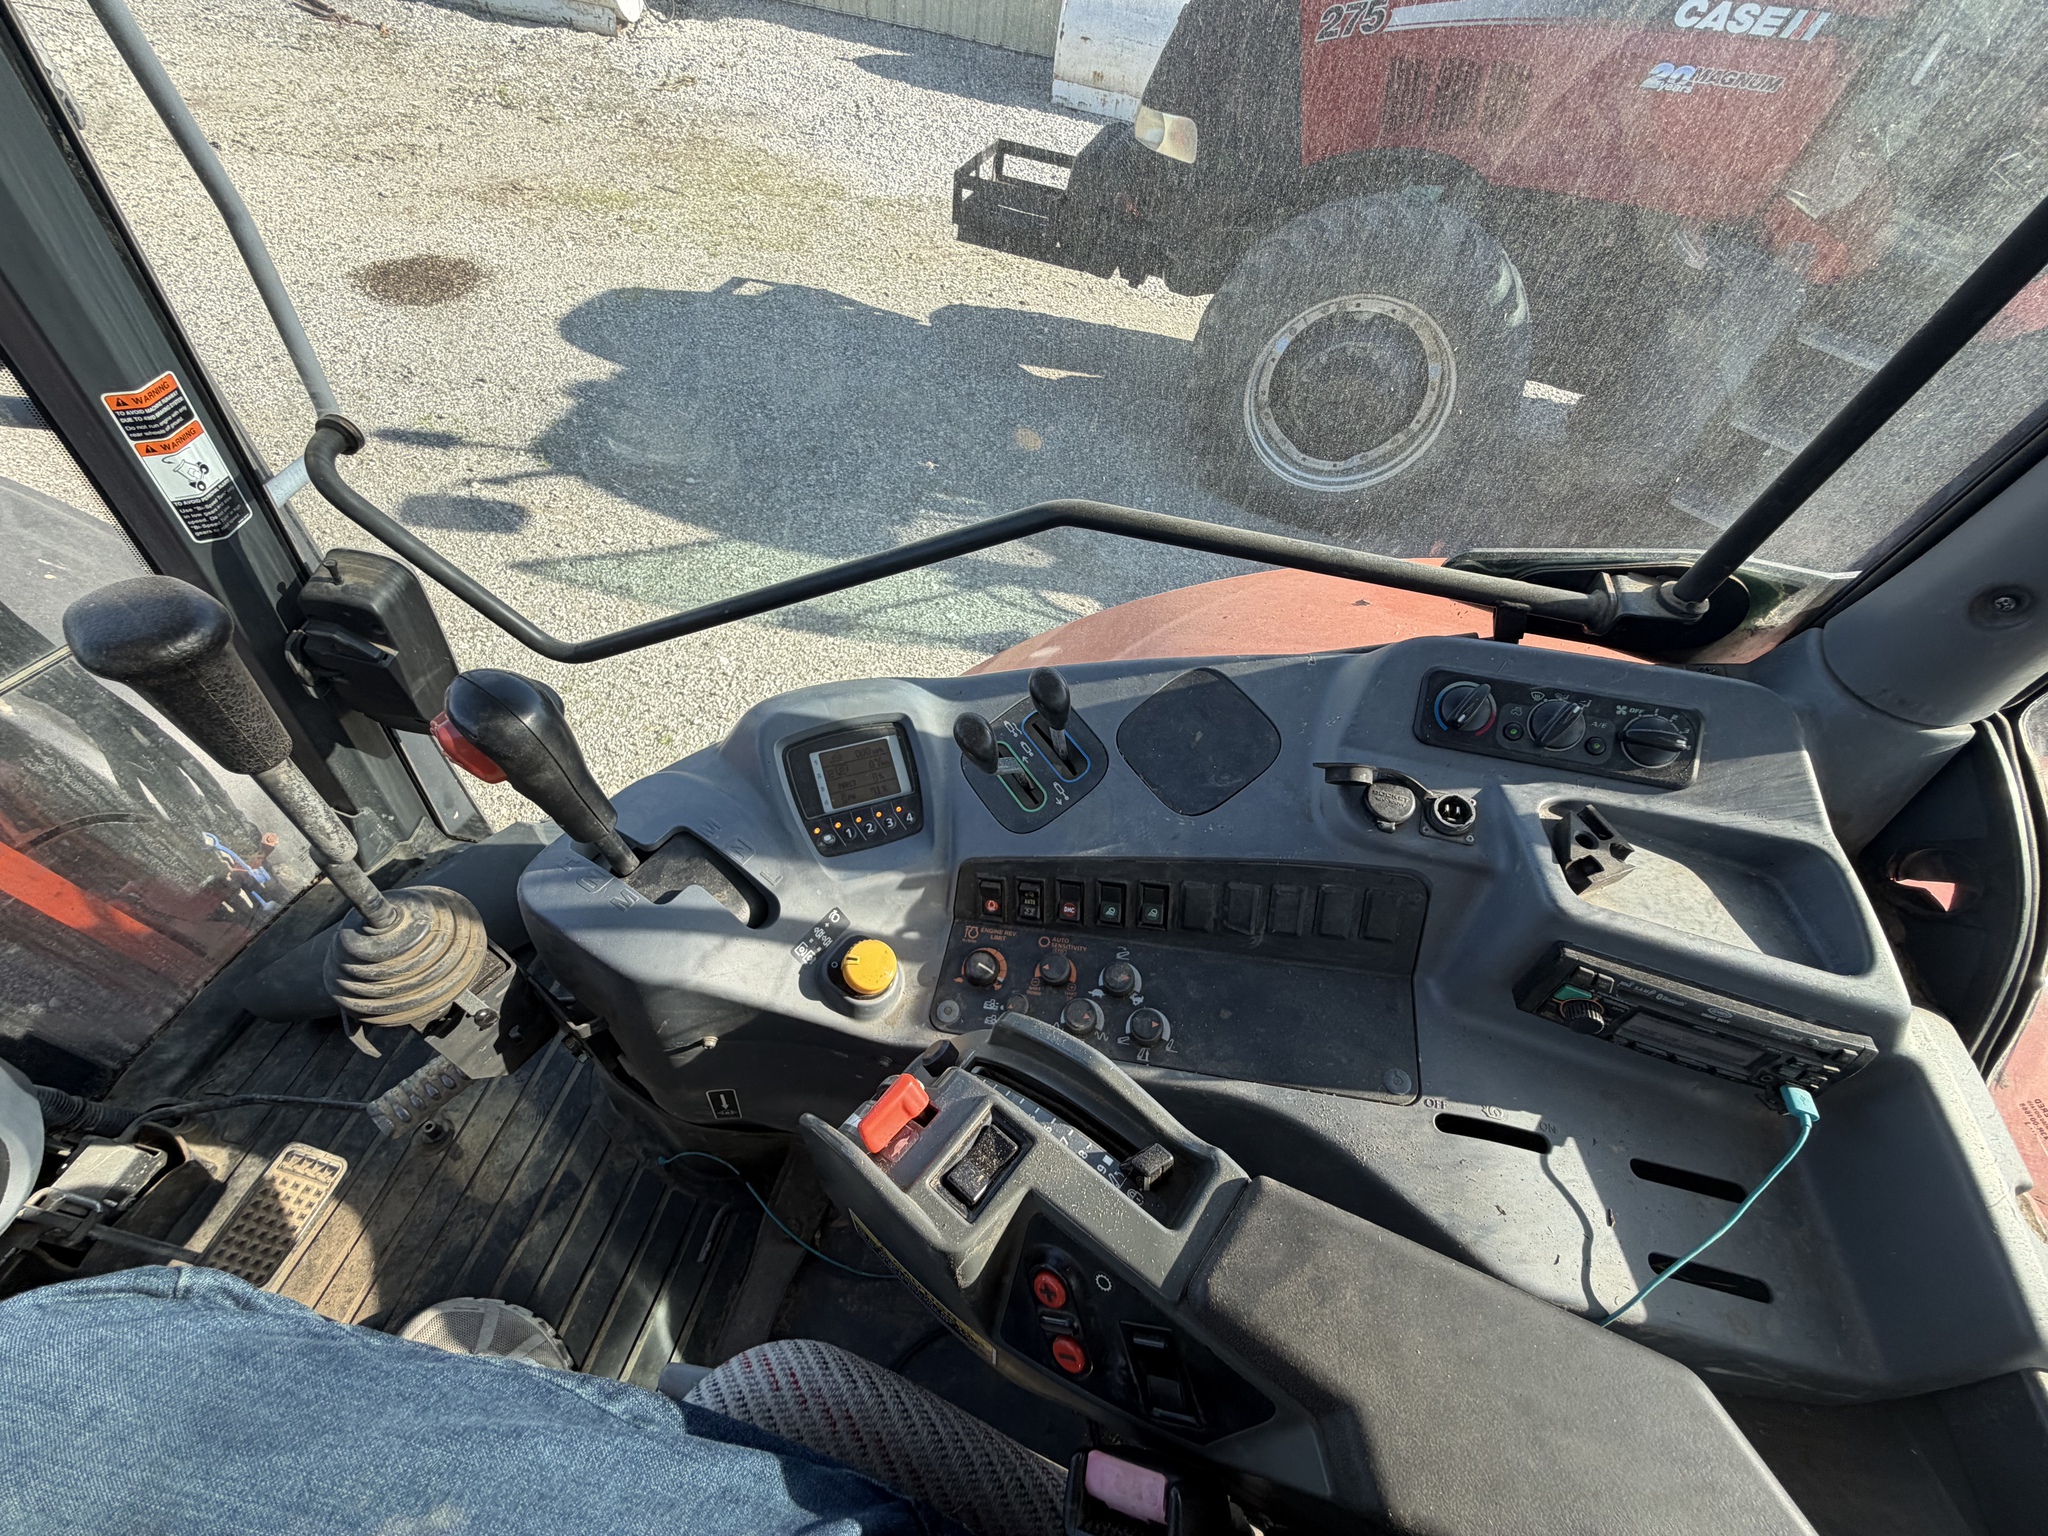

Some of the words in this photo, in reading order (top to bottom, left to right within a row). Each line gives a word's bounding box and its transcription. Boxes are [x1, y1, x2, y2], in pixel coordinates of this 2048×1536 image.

[1315, 0, 1389, 41] 275
[1674, 0, 1791, 37] CASE
[1640, 62, 1696, 89] 20
[1693, 66, 1786, 93] MAGNUM
[131, 381, 170, 405] WARNING
[159, 427, 197, 451] WARNING
[1628, 706, 1645, 714] OFF
[1590, 721, 1608, 729] A/E
[845, 828, 853, 839] 1
[865, 823, 874, 834] 2
[885, 817, 894, 828] 3
[906, 812, 914, 822] 4
[1024, 898, 1037, 906] AUTO
[980, 926, 1003, 936] ENGINE
[1004, 929, 1019, 938] REV.
[990, 934, 1007, 942] LIMIT
[1052, 936, 1070, 945] AUTO
[1050, 942, 1088, 953] SENSITIVITY
[1423, 1098, 1447, 1110] OFF
[1538, 1121, 1557, 1134] ON
[1059, 1135, 1069, 1146] 7
[1077, 1148, 1088, 1160] 8
[1096, 1164, 1107, 1175] 9
